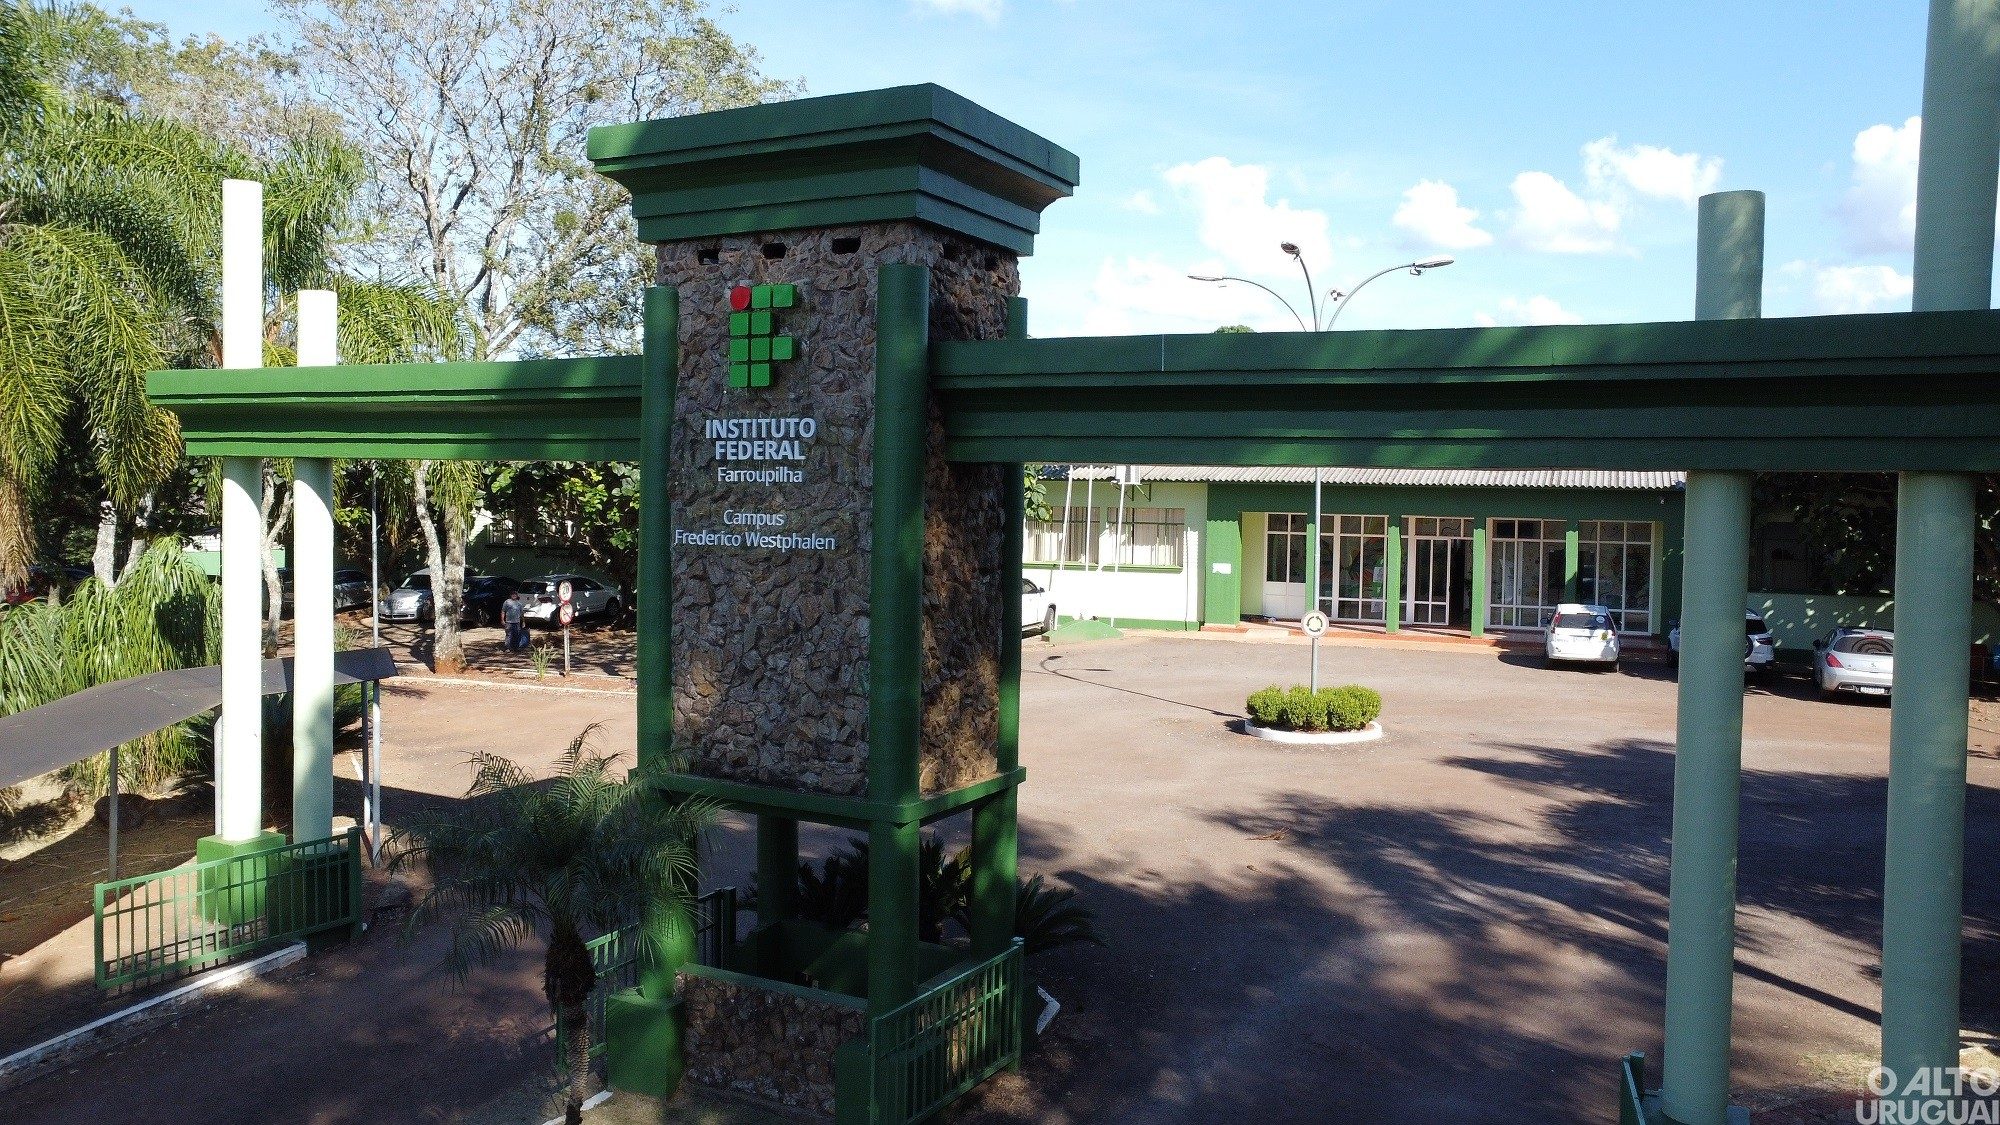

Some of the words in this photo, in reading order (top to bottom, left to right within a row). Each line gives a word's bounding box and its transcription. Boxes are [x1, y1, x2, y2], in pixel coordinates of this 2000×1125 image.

[705, 418, 816, 438] INSTITUTO
[715, 440, 806, 460] FEDERAL
[717, 467, 803, 486] Farroupilha
[723, 510, 784, 529] Campus
[674, 529, 742, 547] Frederico
[745, 532, 836, 553] Westphalen
